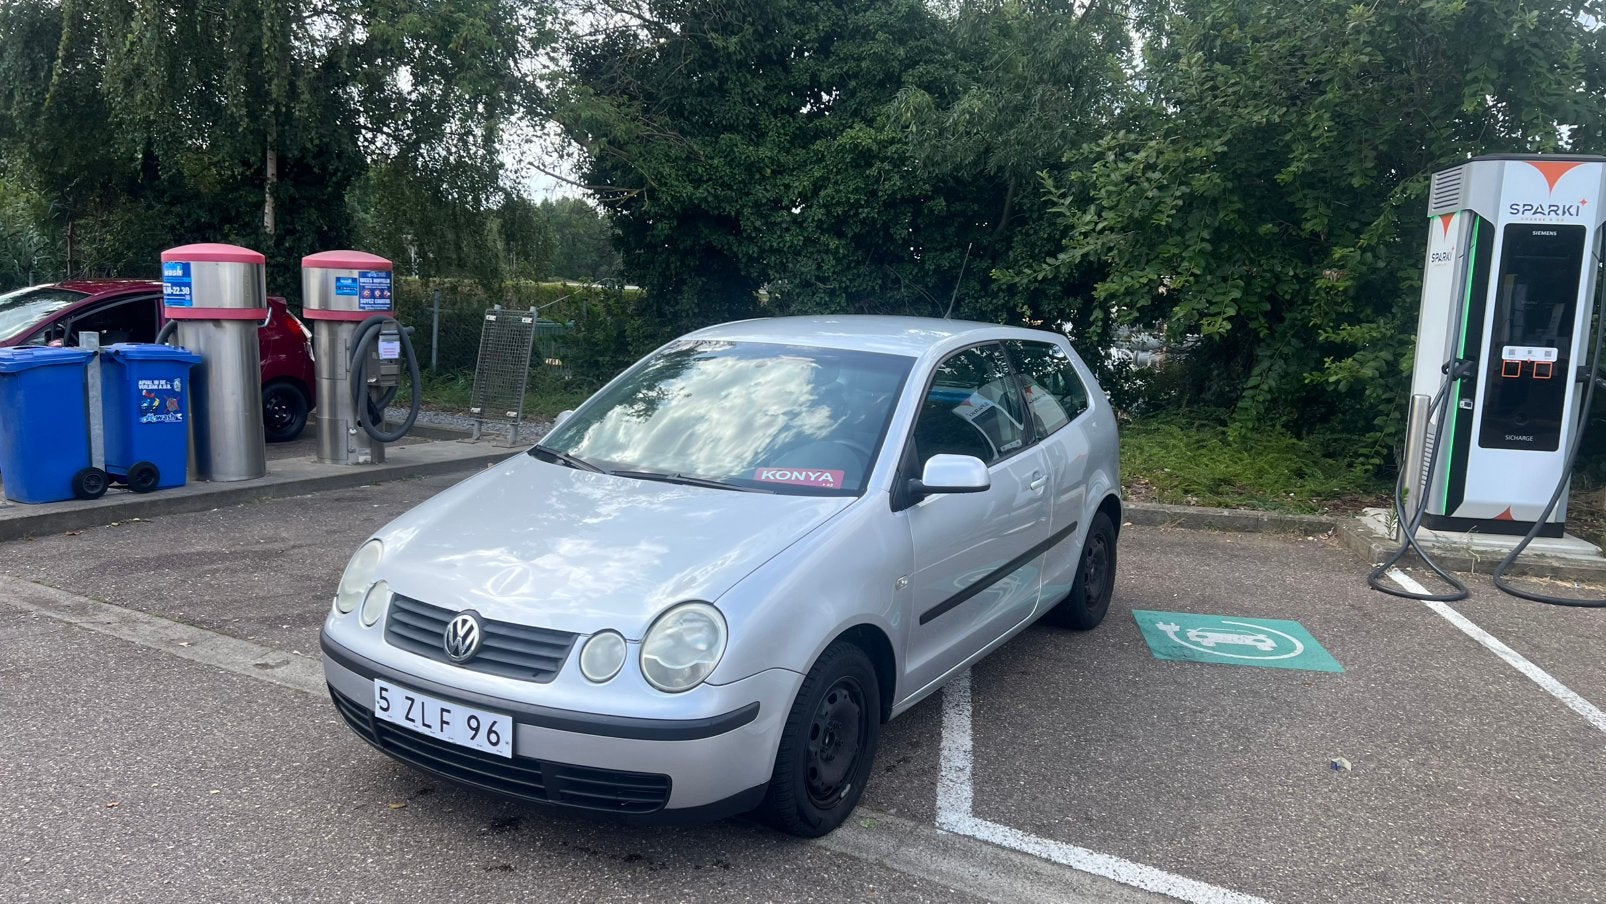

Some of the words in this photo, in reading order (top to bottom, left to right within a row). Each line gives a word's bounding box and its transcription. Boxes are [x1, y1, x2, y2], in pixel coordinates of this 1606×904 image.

[1509, 203, 1580, 217] SPARKI
[1431, 252, 1452, 263] SPARKI
[1505, 434, 1534, 442] SICHARGE
[761, 470, 834, 482] KONYA
[379, 686, 391, 713] 5
[404, 695, 452, 733] ZLF
[466, 714, 501, 747] 96
